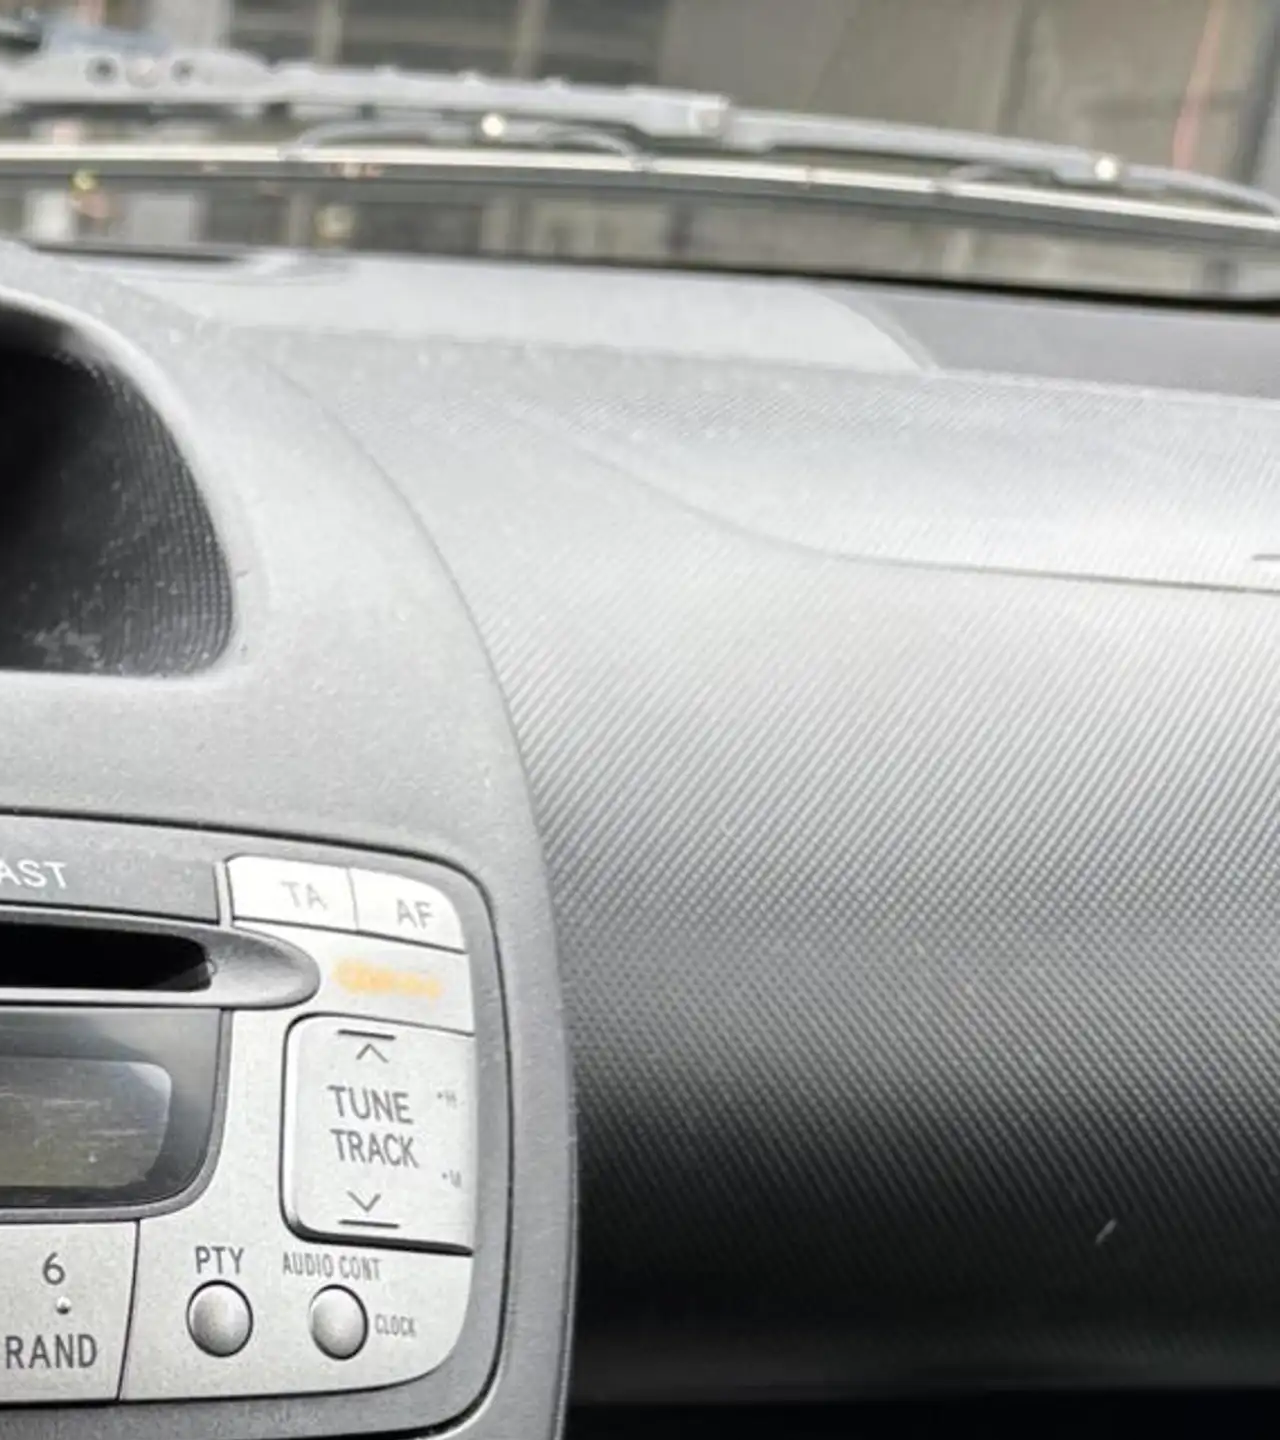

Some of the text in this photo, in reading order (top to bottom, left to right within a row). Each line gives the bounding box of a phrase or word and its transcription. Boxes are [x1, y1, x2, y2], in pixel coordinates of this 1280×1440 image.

[280, 880, 329, 911] TA
[395, 898, 434, 930] AF
[326, 1084, 415, 1125] TUNE
[329, 1128, 421, 1170] TRACK
[41, 1251, 66, 1286] 6
[194, 1245, 246, 1275] PTY
[281, 1251, 383, 1281] AUDIO CONT
[4, 1334, 99, 1371] RAND
